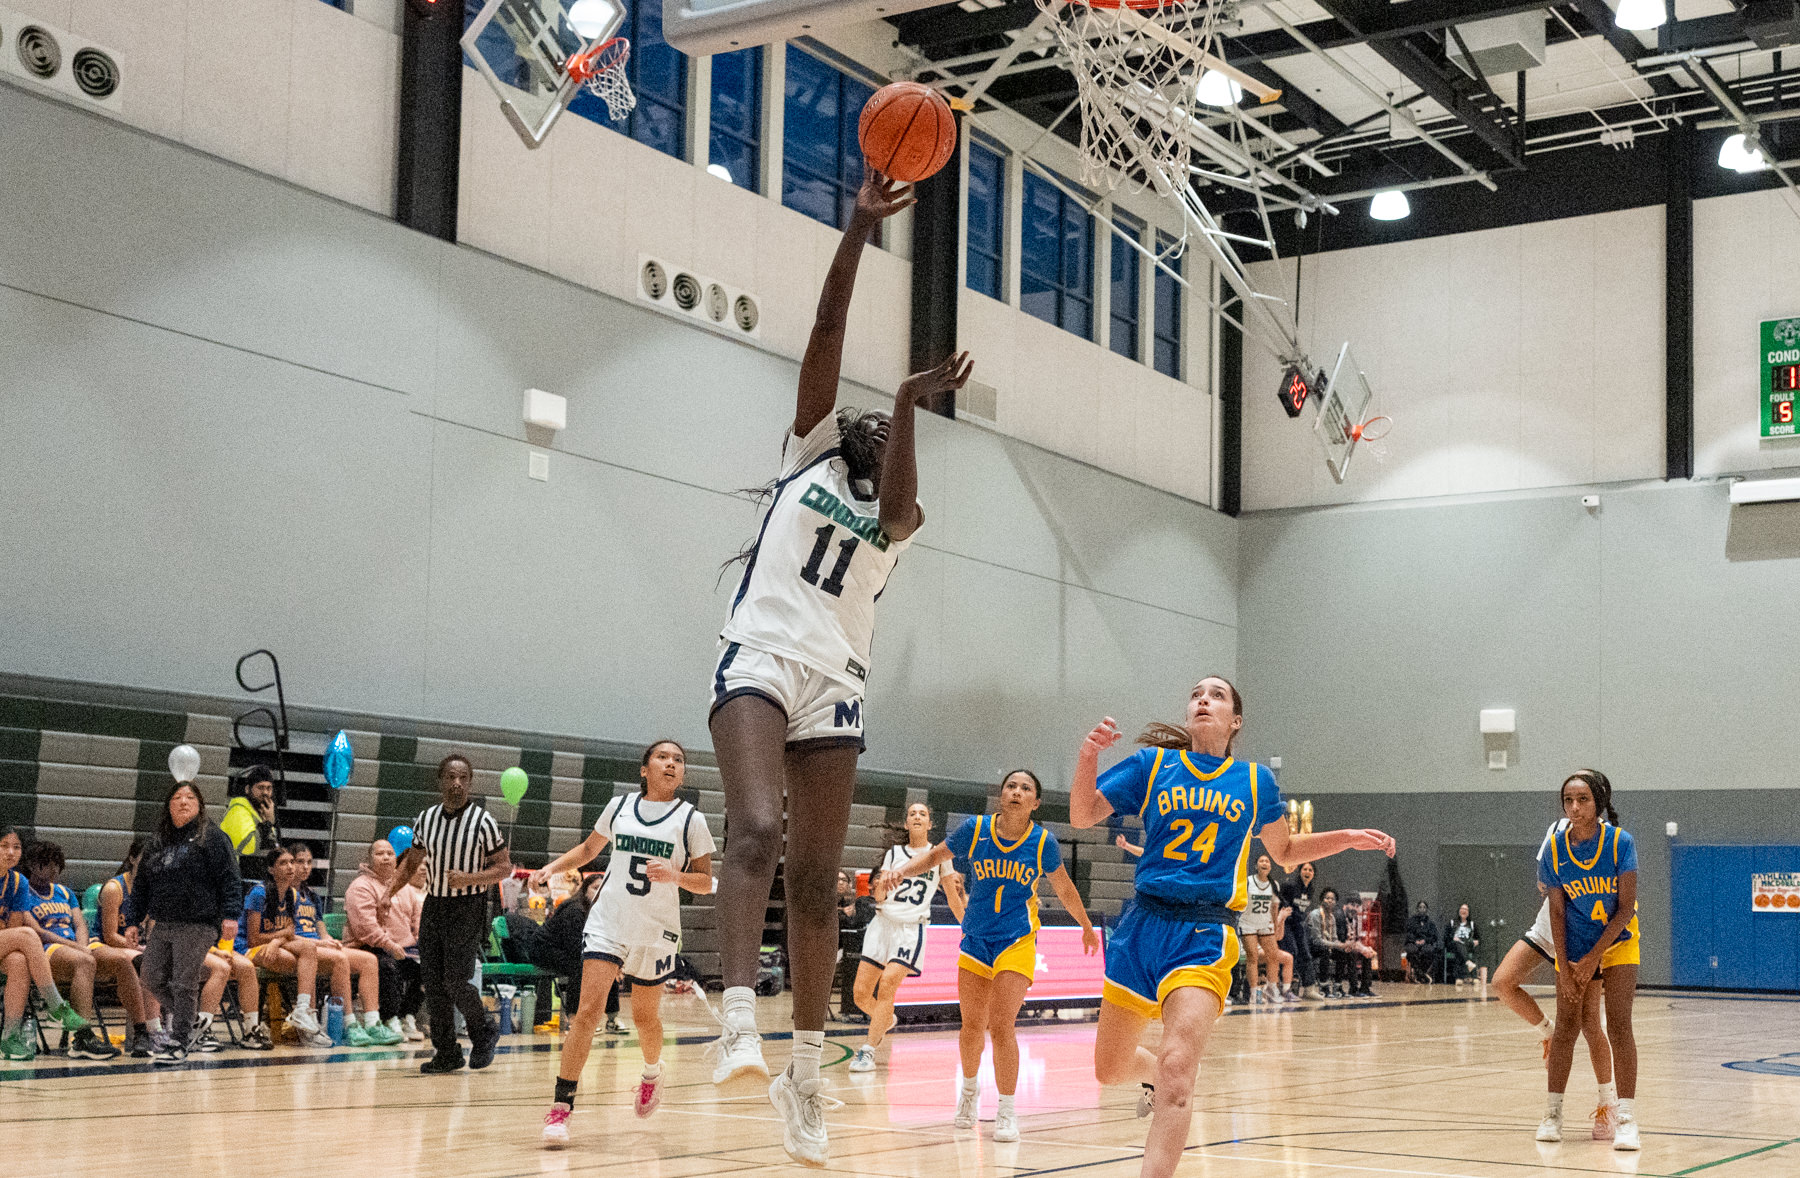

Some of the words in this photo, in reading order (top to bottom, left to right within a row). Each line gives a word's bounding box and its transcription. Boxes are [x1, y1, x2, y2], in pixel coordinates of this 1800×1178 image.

[1289, 374, 1307, 410] 25
[1769, 392, 1795, 402] FOULS
[1779, 401, 1793, 422] 5
[1769, 425, 1796, 435] SCORE
[800, 523, 860, 598] 11
[834, 700, 860, 728] M
[1158, 786, 1246, 822] BRUINS
[616, 834, 675, 860] CONDORS
[1163, 819, 1219, 864] 24
[626, 855, 653, 896] 5
[973, 859, 1035, 886] BRUINS
[894, 878, 927, 906] 23
[995, 885, 1005, 913] 1
[32, 901, 73, 921] BRUIN
[1252, 901, 1270, 914] 25
[1591, 900, 1609, 926] 4
[655, 955, 672, 975] M
[898, 947, 911, 960] M
